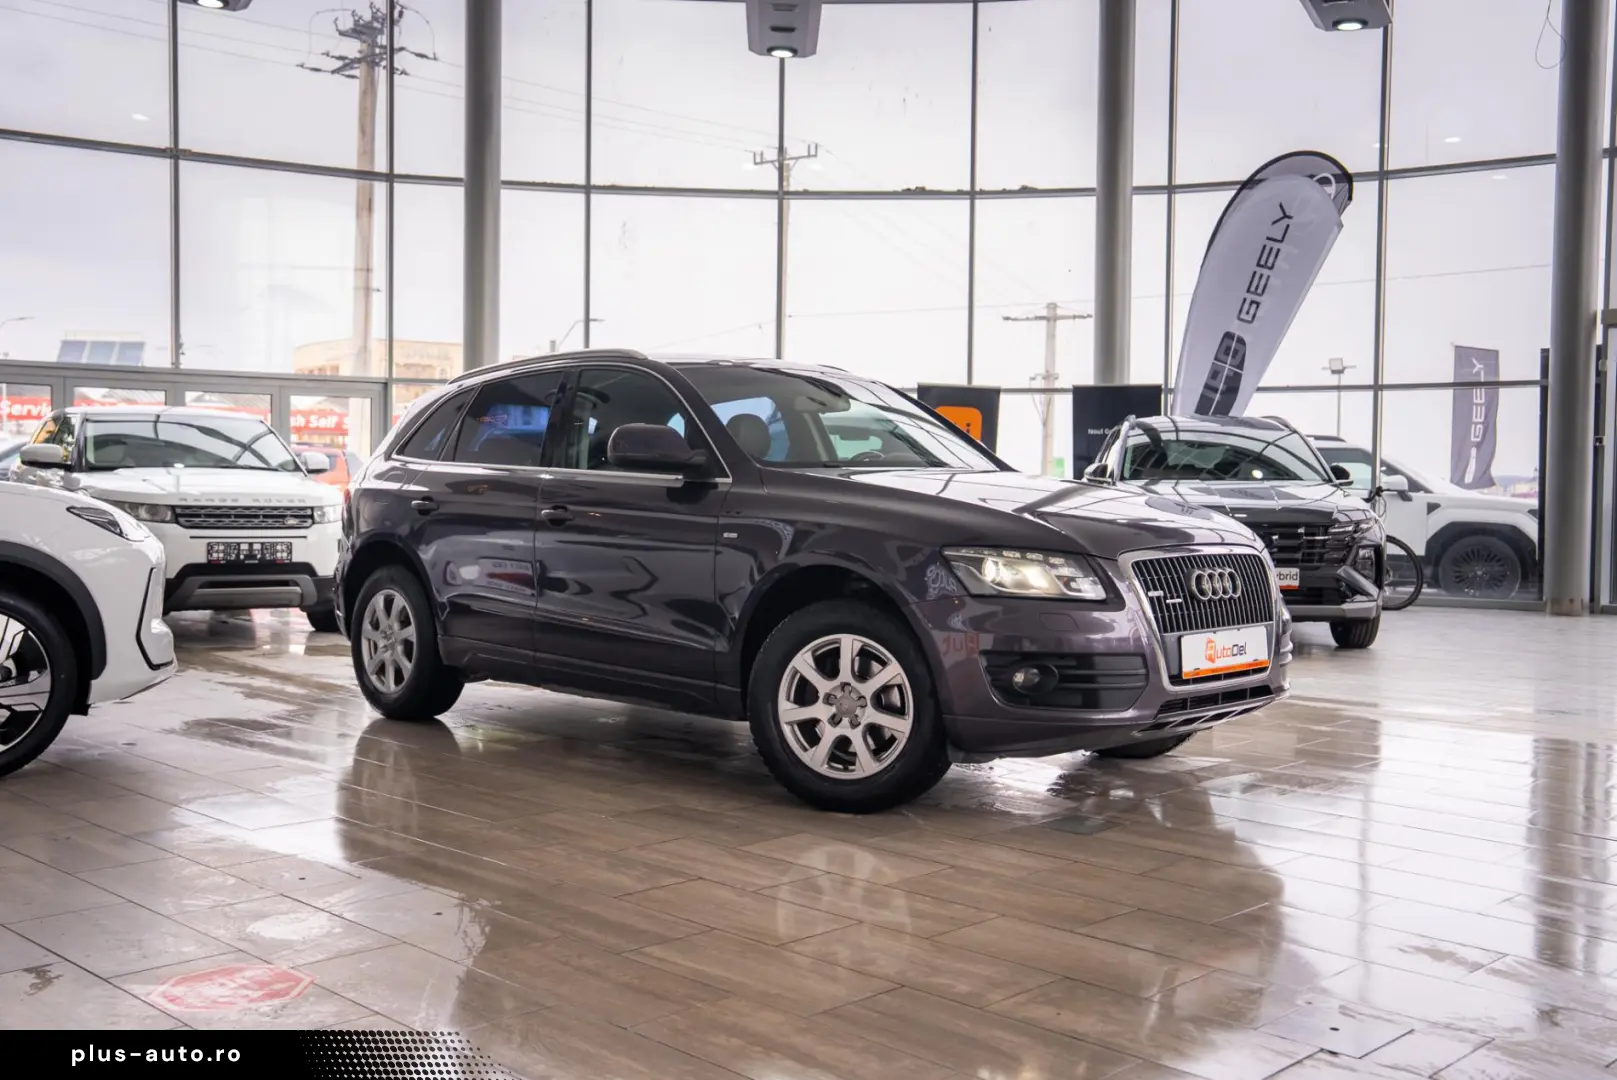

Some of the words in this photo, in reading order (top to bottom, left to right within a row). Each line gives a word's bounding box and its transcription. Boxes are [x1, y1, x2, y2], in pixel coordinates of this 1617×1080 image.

[1237, 202, 1294, 324] GEELY
[1276, 571, 1298, 581] brid
[1205, 637, 1247, 664] AutoDel
